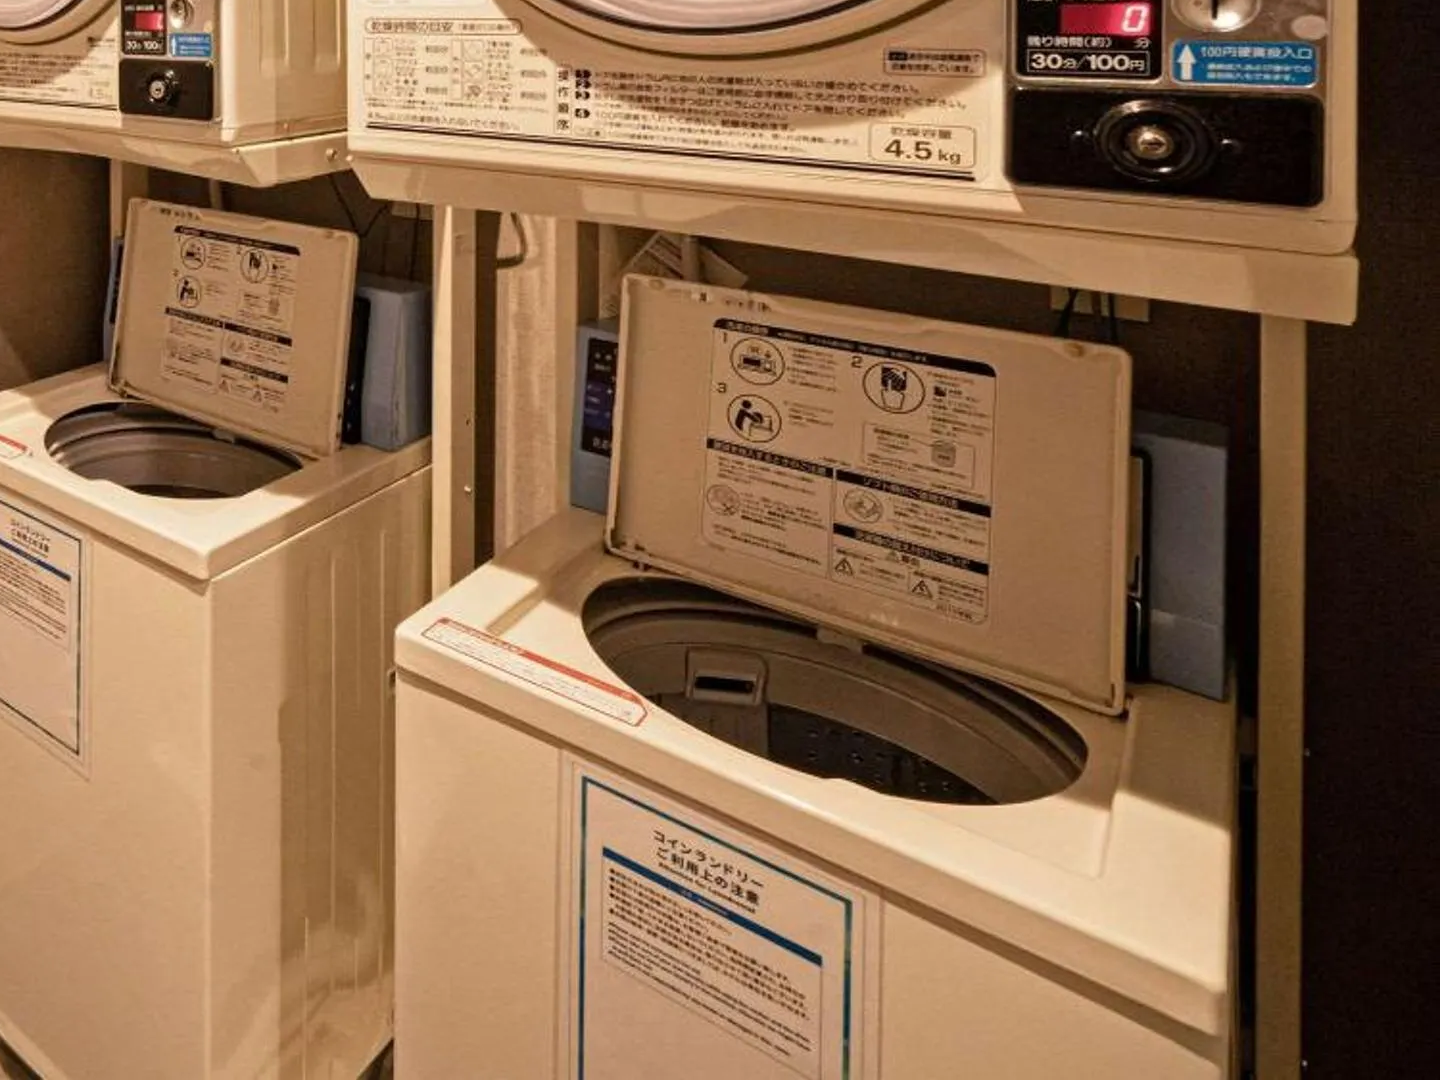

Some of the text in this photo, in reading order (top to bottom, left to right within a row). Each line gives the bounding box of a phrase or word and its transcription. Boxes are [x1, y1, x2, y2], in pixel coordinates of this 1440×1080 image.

[1121, 4, 1150, 33] 0
[1030, 53, 1147, 72] 30分/100円
[884, 138, 933, 161] 4.5
[653, 829, 765, 888] コインランドリー
[656, 846, 760, 906] ご利用上の注意
